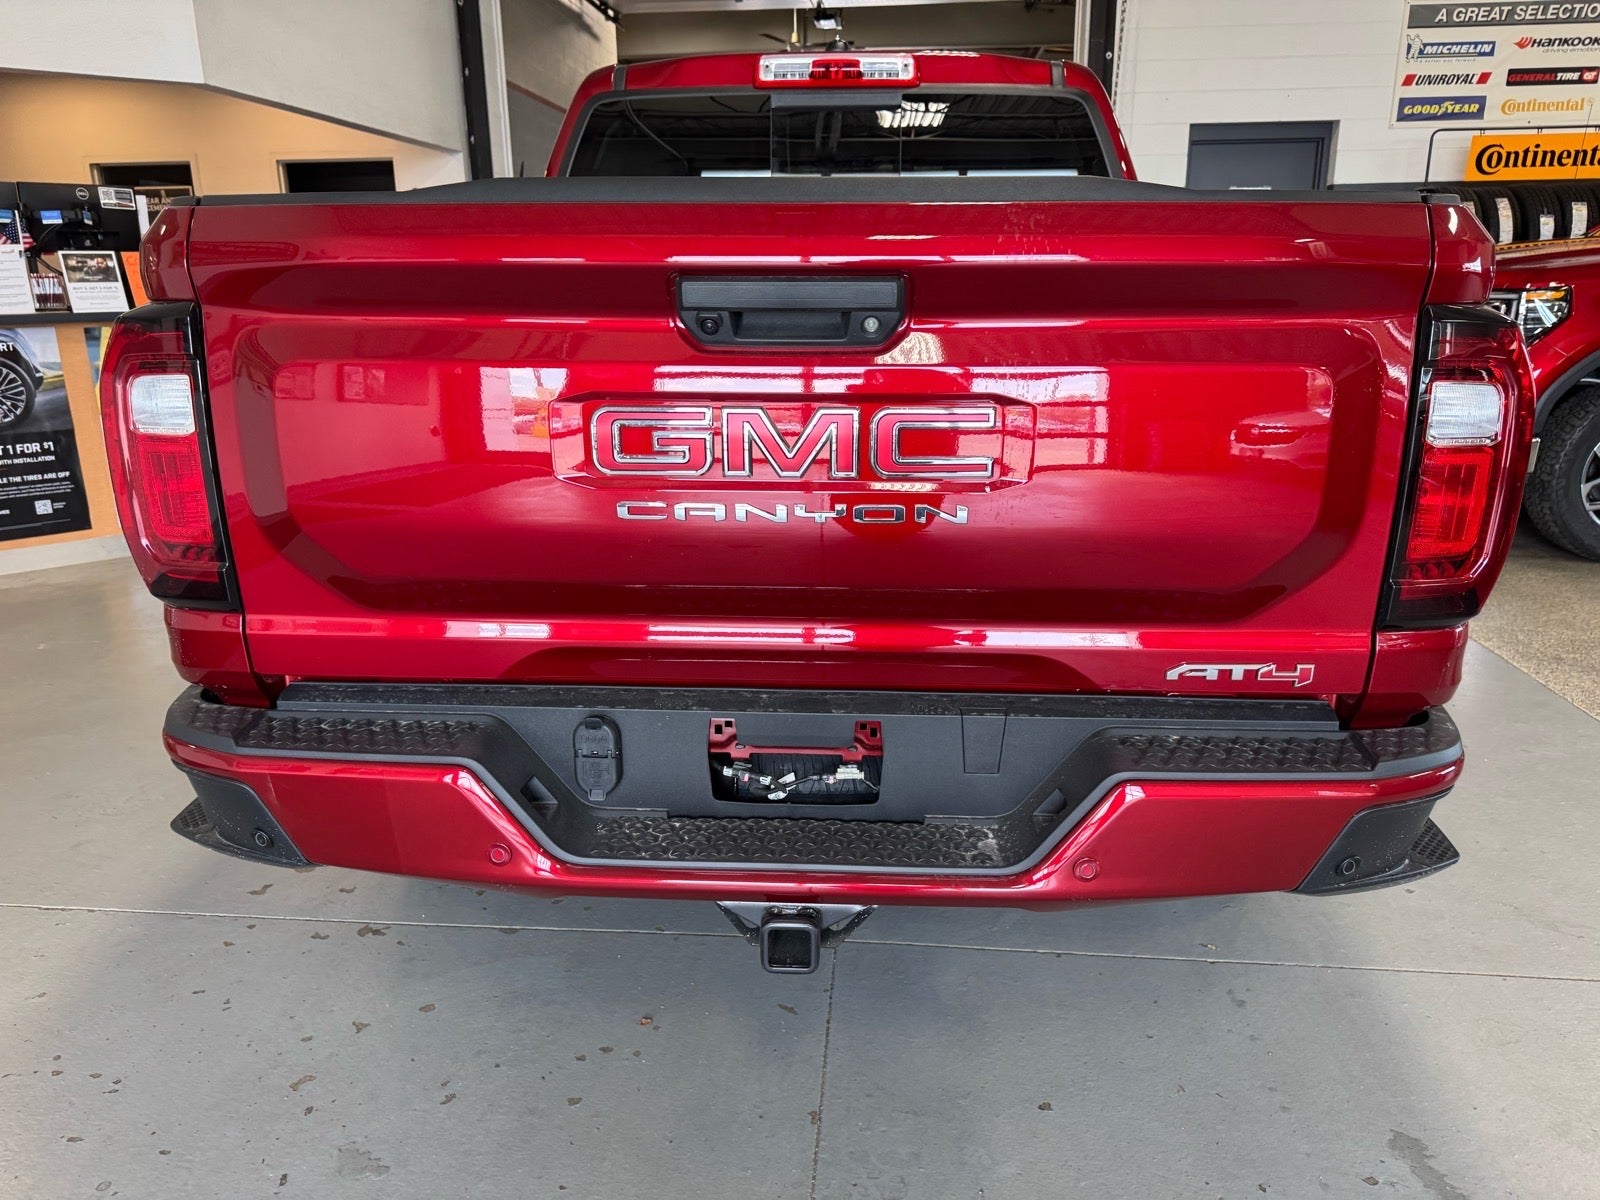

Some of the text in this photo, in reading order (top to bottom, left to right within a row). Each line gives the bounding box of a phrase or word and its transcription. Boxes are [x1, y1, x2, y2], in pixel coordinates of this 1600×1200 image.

[1434, 8, 1448, 23] A
[1452, 6, 1513, 22] GREAT
[1423, 44, 1493, 55] MICHELIN
[1415, 73, 1476, 86] UNIROYAL
[1403, 101, 1480, 116] GOODYEAR
[1501, 97, 1585, 116] Continental
[1475, 143, 1600, 175] Continent
[6, 445, 14, 455] 1
[16, 442, 42, 454] FOR
[43, 441, 55, 451] $1
[590, 405, 998, 479] GMC
[13, 455, 55, 464] INSTALLATION
[8, 475, 22, 483] THE
[43, 472, 57, 480] ARE
[616, 501, 969, 524] CANYON
[1166, 661, 1316, 687] AT4
